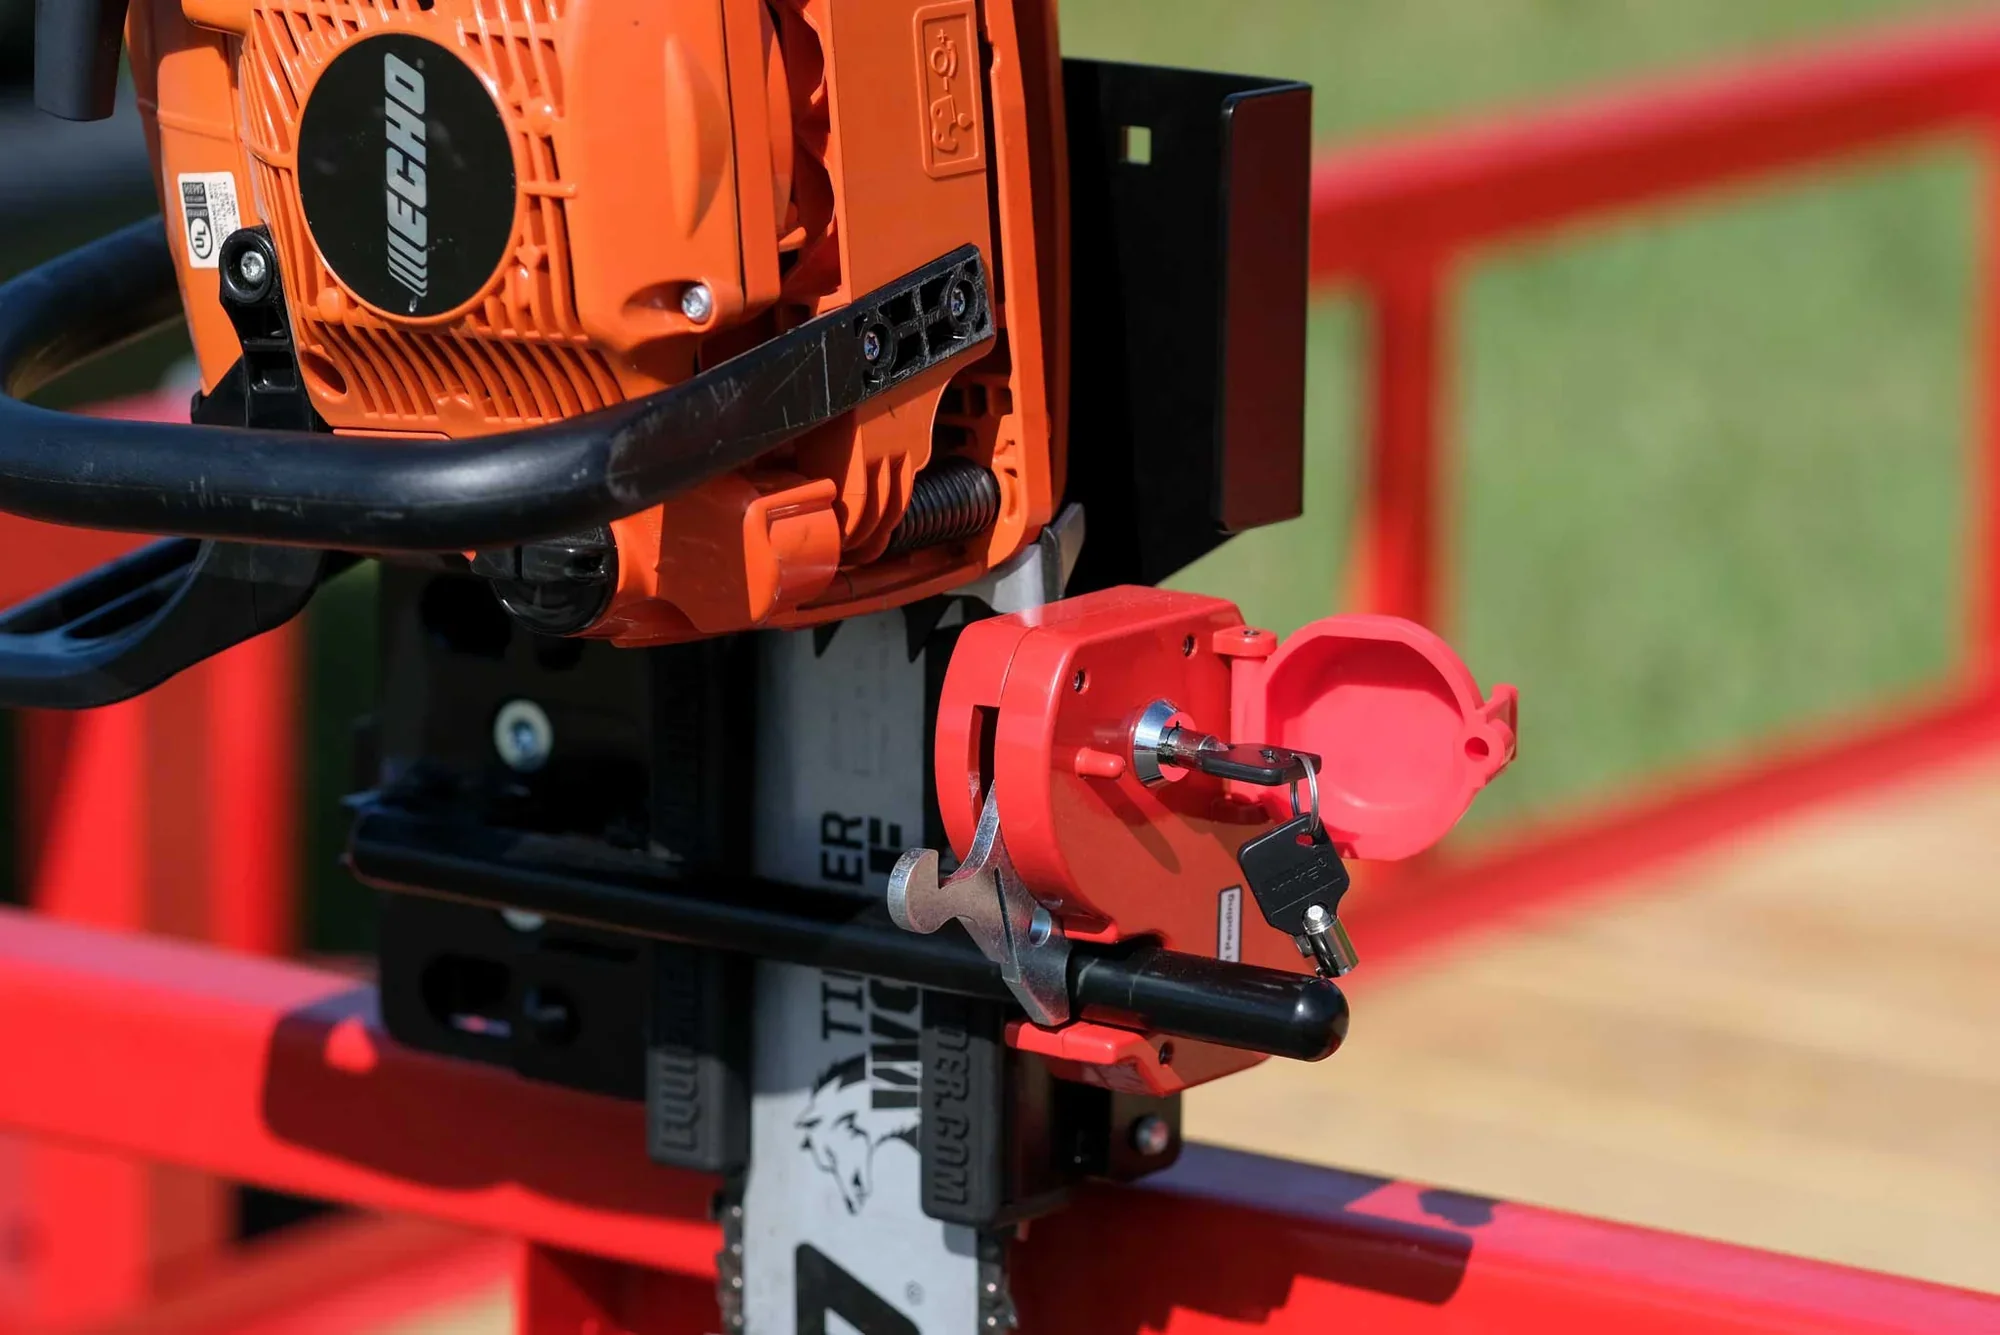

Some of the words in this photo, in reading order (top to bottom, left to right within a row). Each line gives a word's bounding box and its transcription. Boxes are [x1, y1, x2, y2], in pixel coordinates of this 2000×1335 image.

[194, 225, 207, 249] UL
[384, 51, 428, 250] ECHO
[932, 1024, 971, 1207] DER.COM
